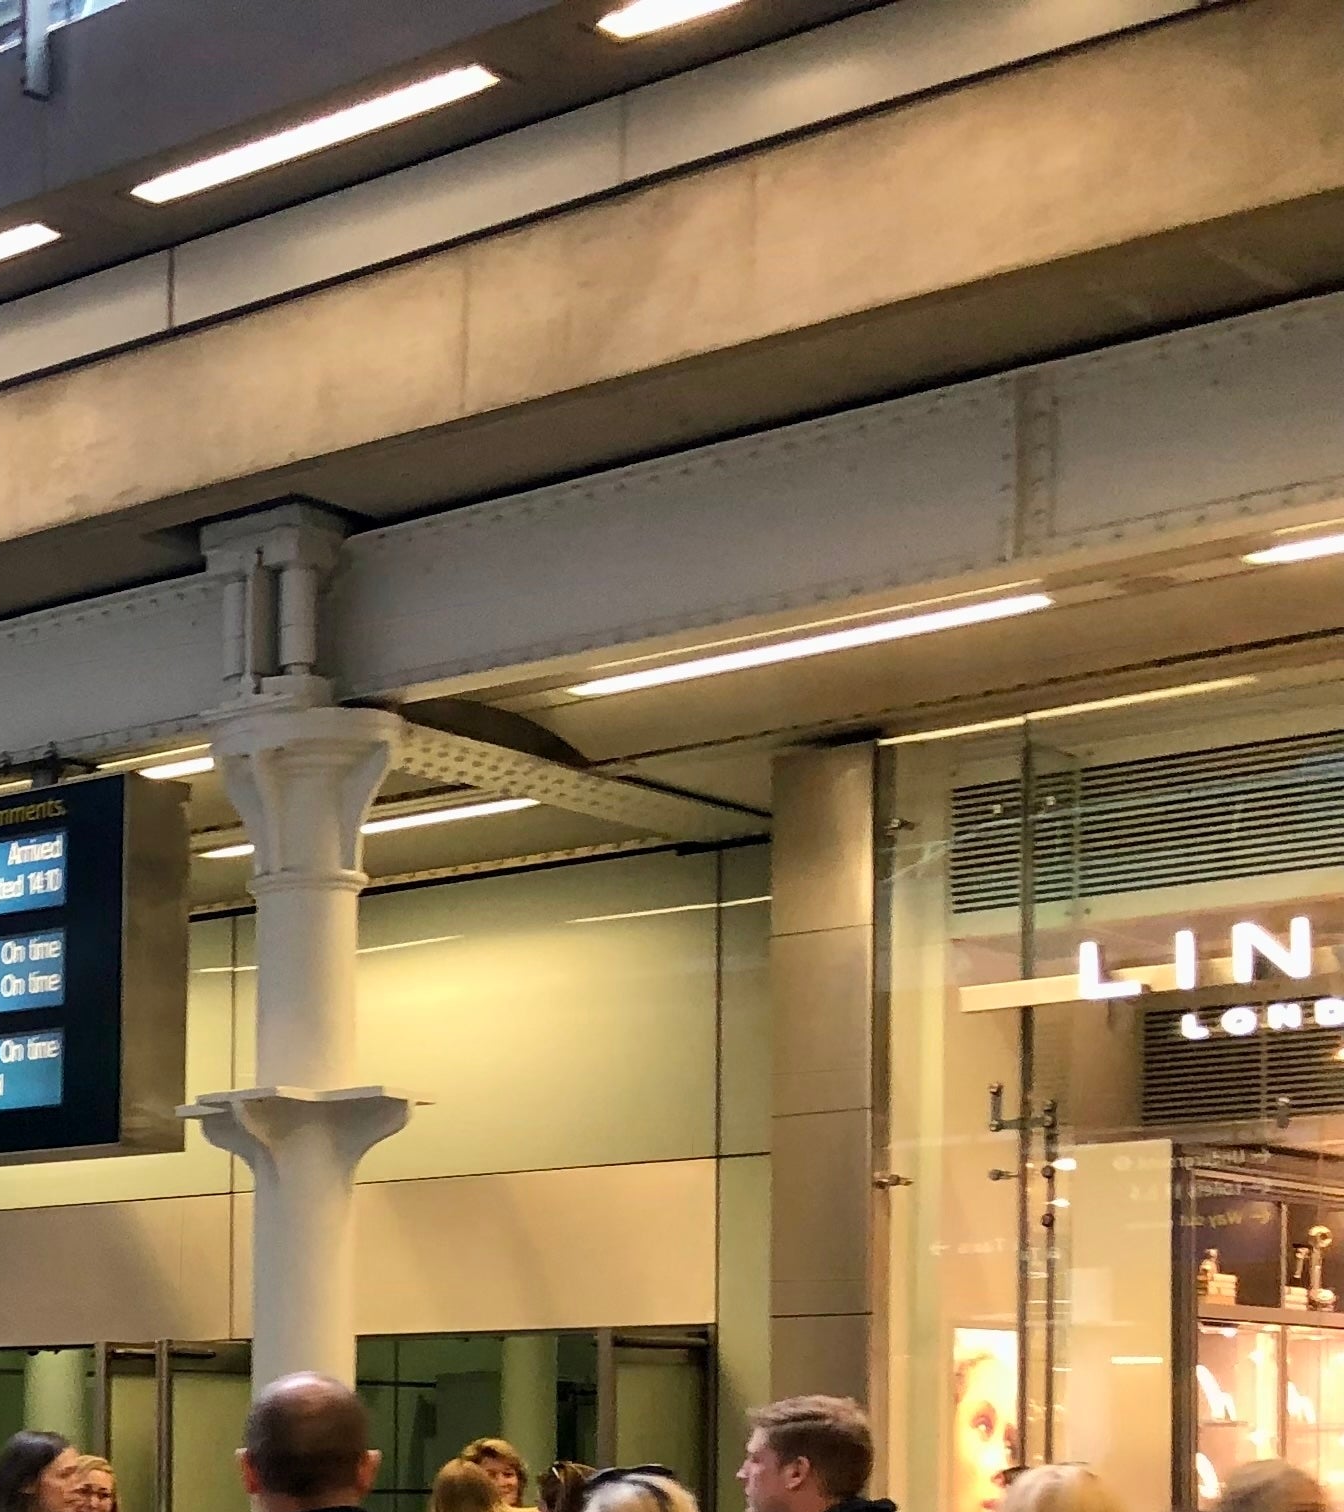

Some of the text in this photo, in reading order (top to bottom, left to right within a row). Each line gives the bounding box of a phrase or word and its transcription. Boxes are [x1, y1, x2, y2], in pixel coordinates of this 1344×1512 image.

[7, 834, 64, 866] Arrived
[0, 940, 26, 965] On
[28, 936, 62, 961] time
[0, 973, 26, 998] On
[28, 970, 62, 994] time
[0, 1039, 25, 1063] On
[27, 1036, 61, 1060] time
